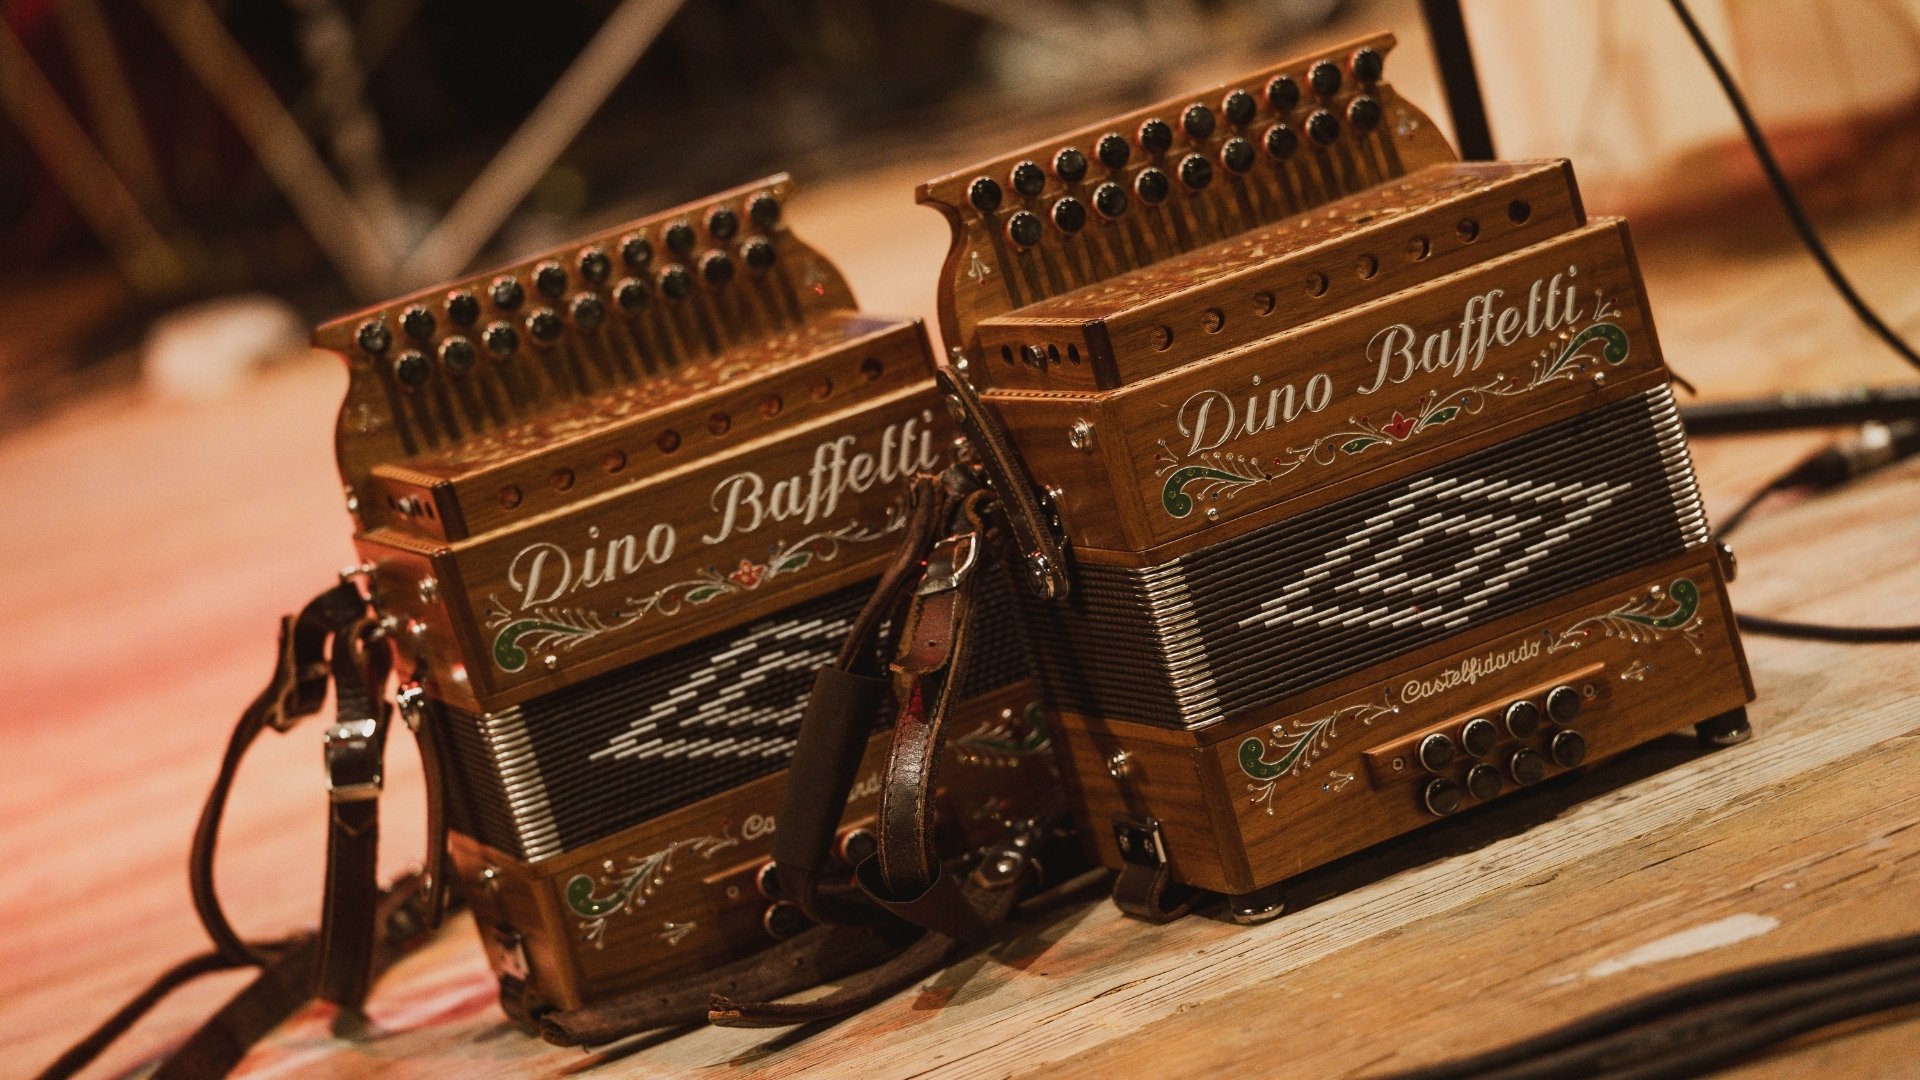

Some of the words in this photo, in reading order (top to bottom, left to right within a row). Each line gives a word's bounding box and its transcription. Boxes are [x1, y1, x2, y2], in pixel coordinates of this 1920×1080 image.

[1177, 374, 1333, 456] Dino
[1358, 265, 1583, 395] Baffetti
[509, 523, 676, 610] Dino
[703, 410, 939, 545] Baffetti
[1401, 640, 1541, 704] Castelfidardo
